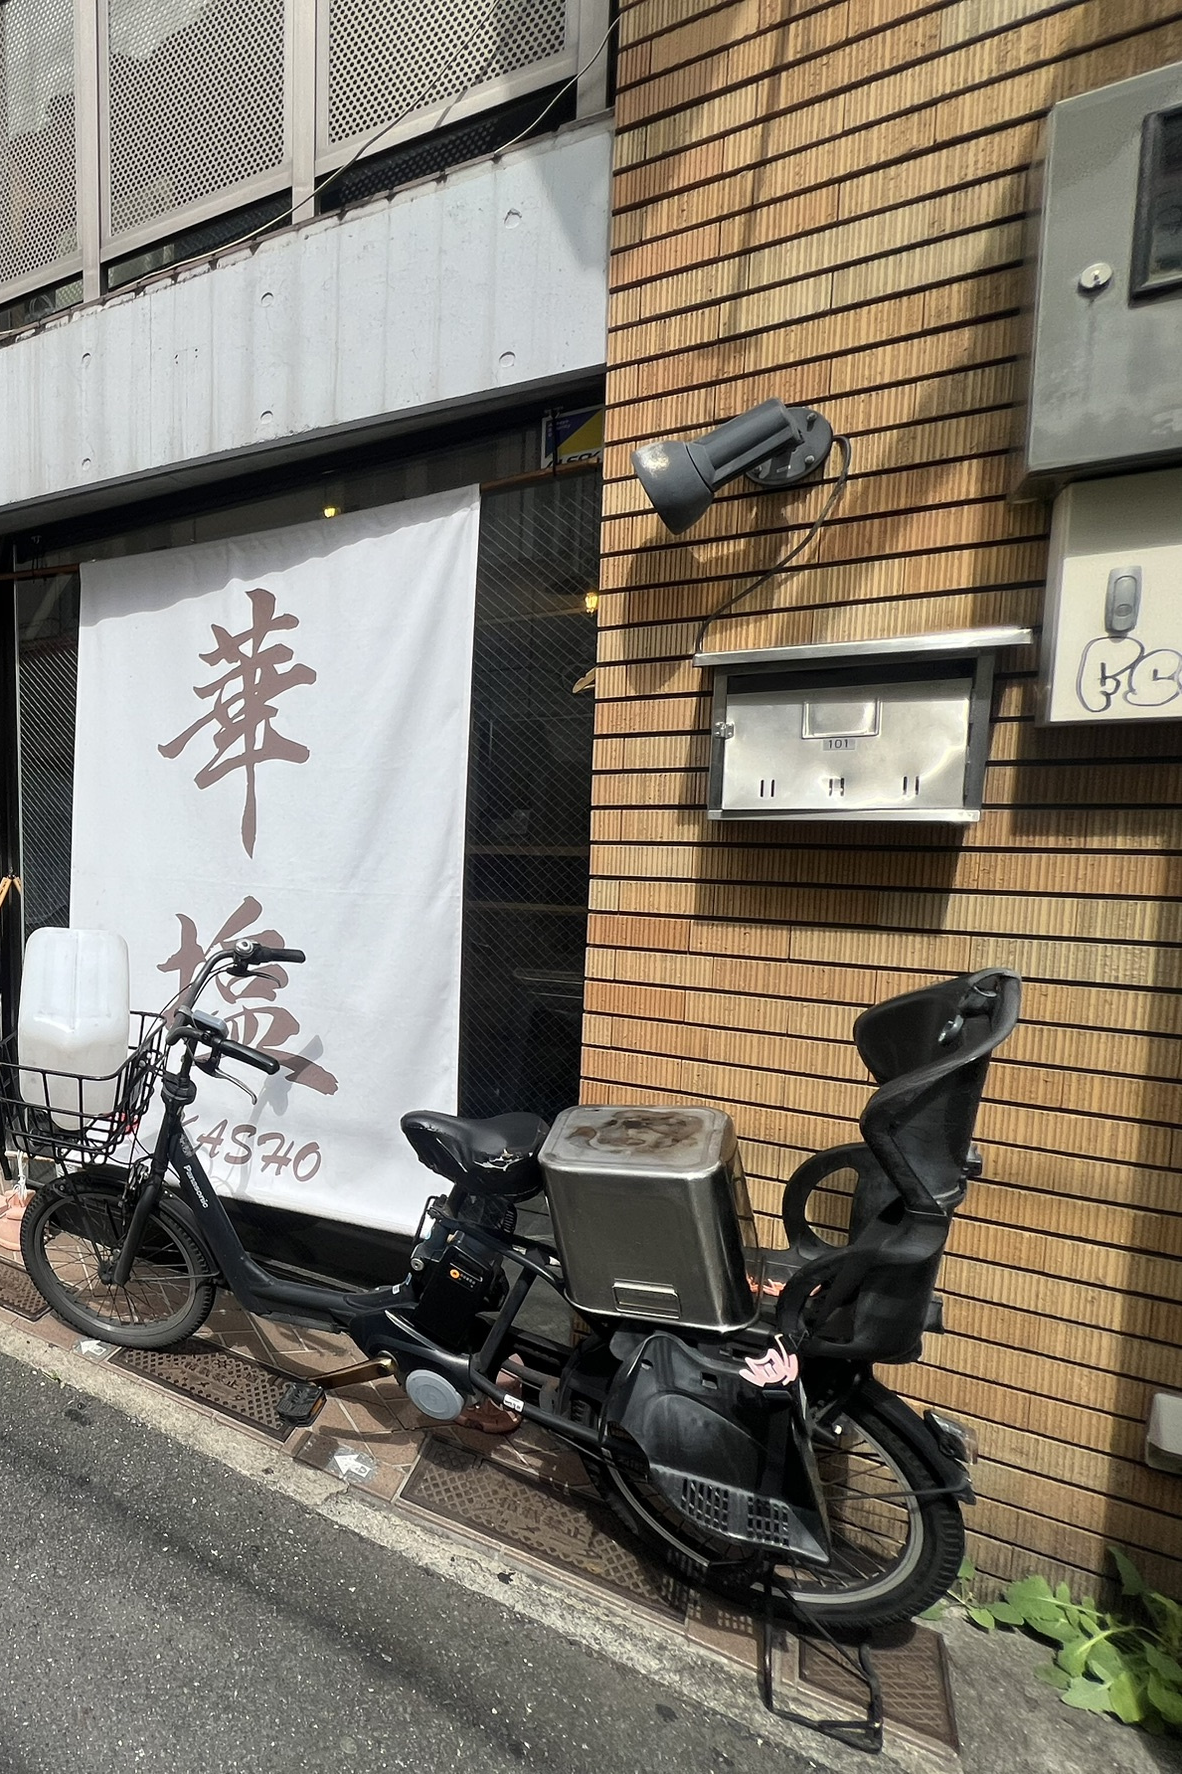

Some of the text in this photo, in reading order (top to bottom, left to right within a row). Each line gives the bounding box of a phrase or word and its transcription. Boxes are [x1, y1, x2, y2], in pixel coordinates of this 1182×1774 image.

[828, 739, 848, 749] 101
[181, 1114, 322, 1183] ASHO
[183, 1164, 209, 1209] Panasonic
